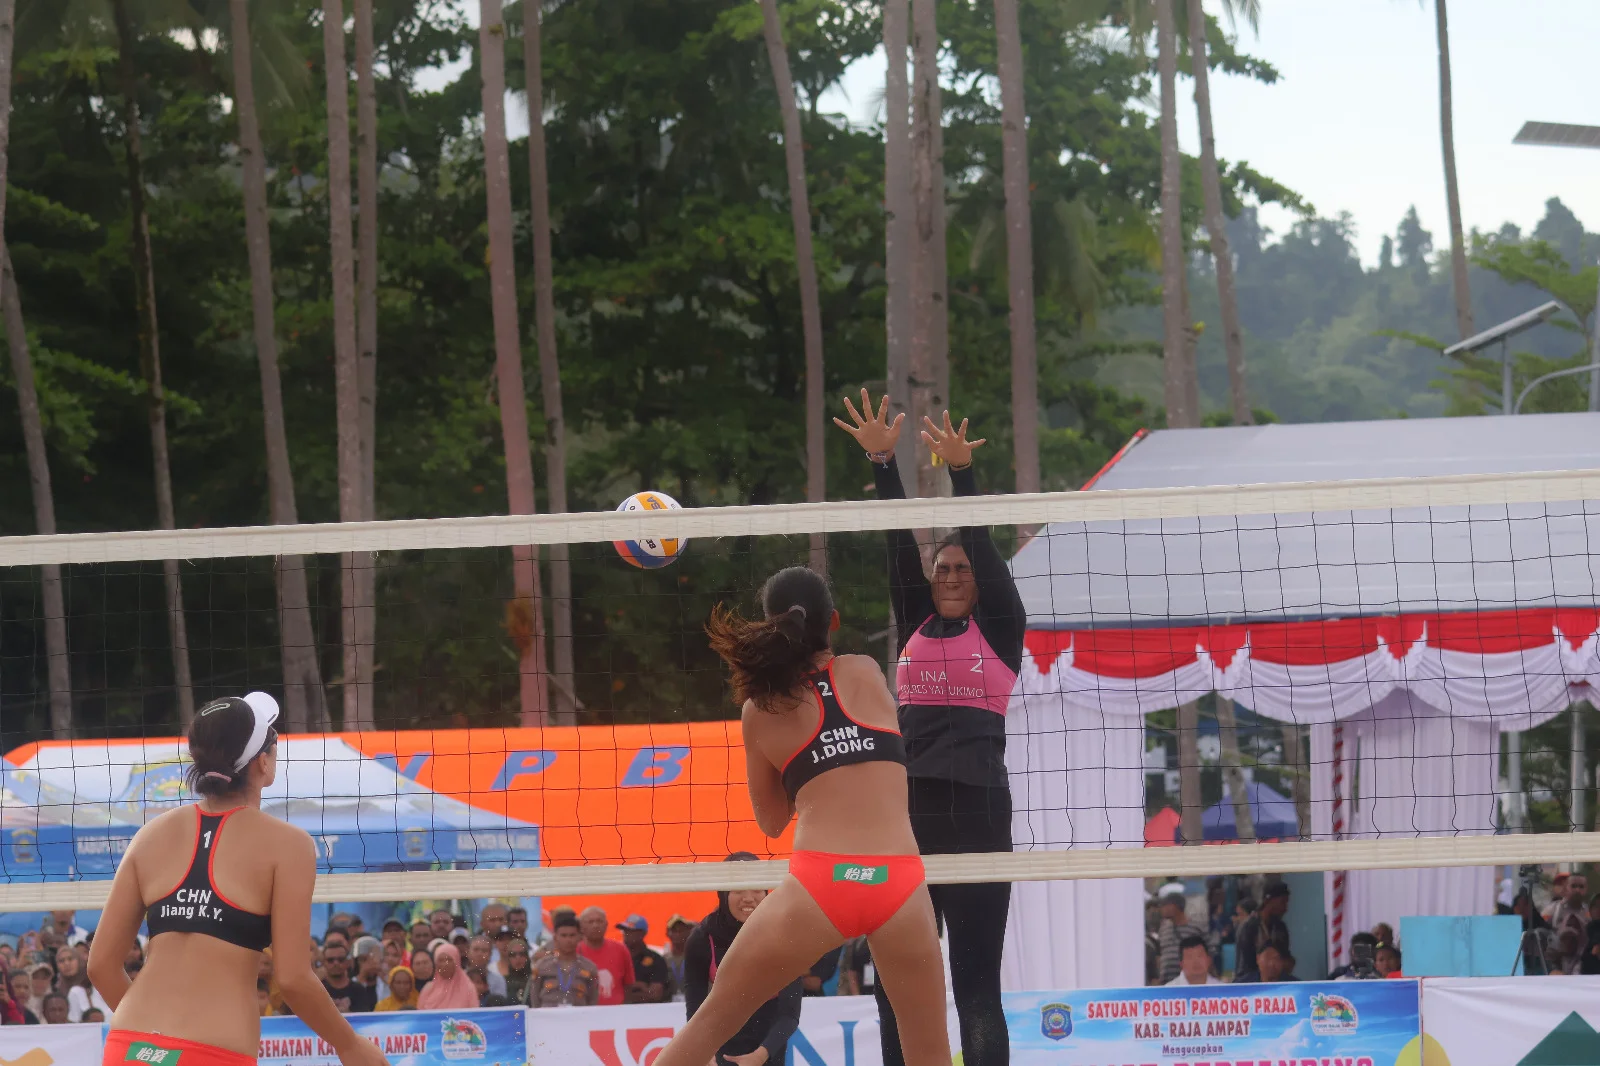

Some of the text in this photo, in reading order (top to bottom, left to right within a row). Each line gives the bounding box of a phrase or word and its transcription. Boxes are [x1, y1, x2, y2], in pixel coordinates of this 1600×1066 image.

[970, 653, 983, 673] 2
[920, 671, 949, 682] INA
[817, 681, 833, 697] 2
[820, 725, 858, 743] CHN
[812, 737, 875, 763] J.DONG
[203, 831, 212, 848] 1
[176, 889, 213, 904] CHN
[160, 905, 194, 919] Jiang
[1088, 1001, 1138, 1018] SATUAN
[1143, 999, 1186, 1017] POLISI
[1192, 998, 1249, 1015] PAMONG
[1254, 996, 1296, 1014] PRAJA
[1134, 1020, 1250, 1039] KAB. RAJA AMPAT
[259, 1038, 312, 1058] SEHATAN
[317, 1037, 338, 1056] KA
[385, 1034, 426, 1054] AMPAT
[1162, 1044, 1223, 1056] Mengucapkan
